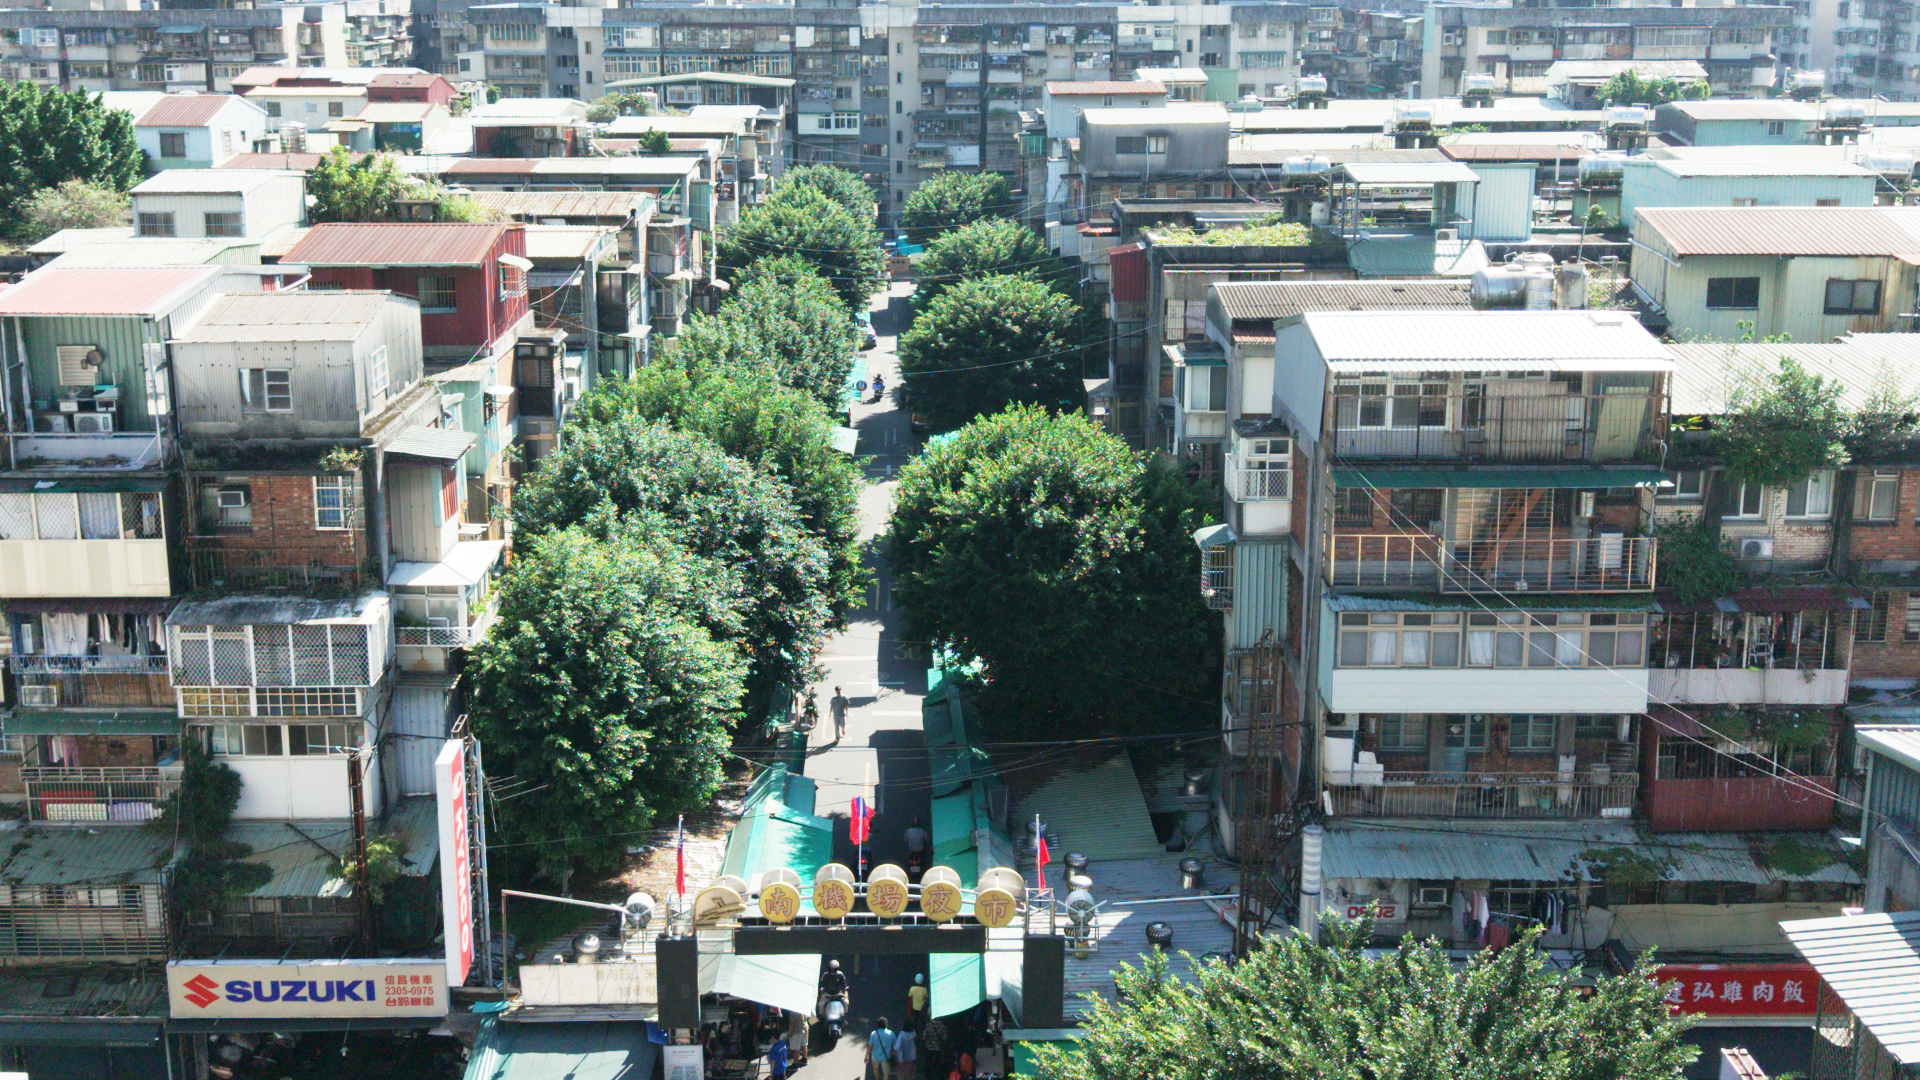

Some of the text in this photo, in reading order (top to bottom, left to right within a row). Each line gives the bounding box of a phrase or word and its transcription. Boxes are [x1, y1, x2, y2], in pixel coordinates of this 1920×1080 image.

[455, 806, 470, 953] KYMCO
[765, 879, 1010, 926] 南機場夜市
[225, 980, 375, 1002] SUZUKI
[385, 975, 433, 985] 信昌機車
[385, 987, 434, 995] 2305-0975
